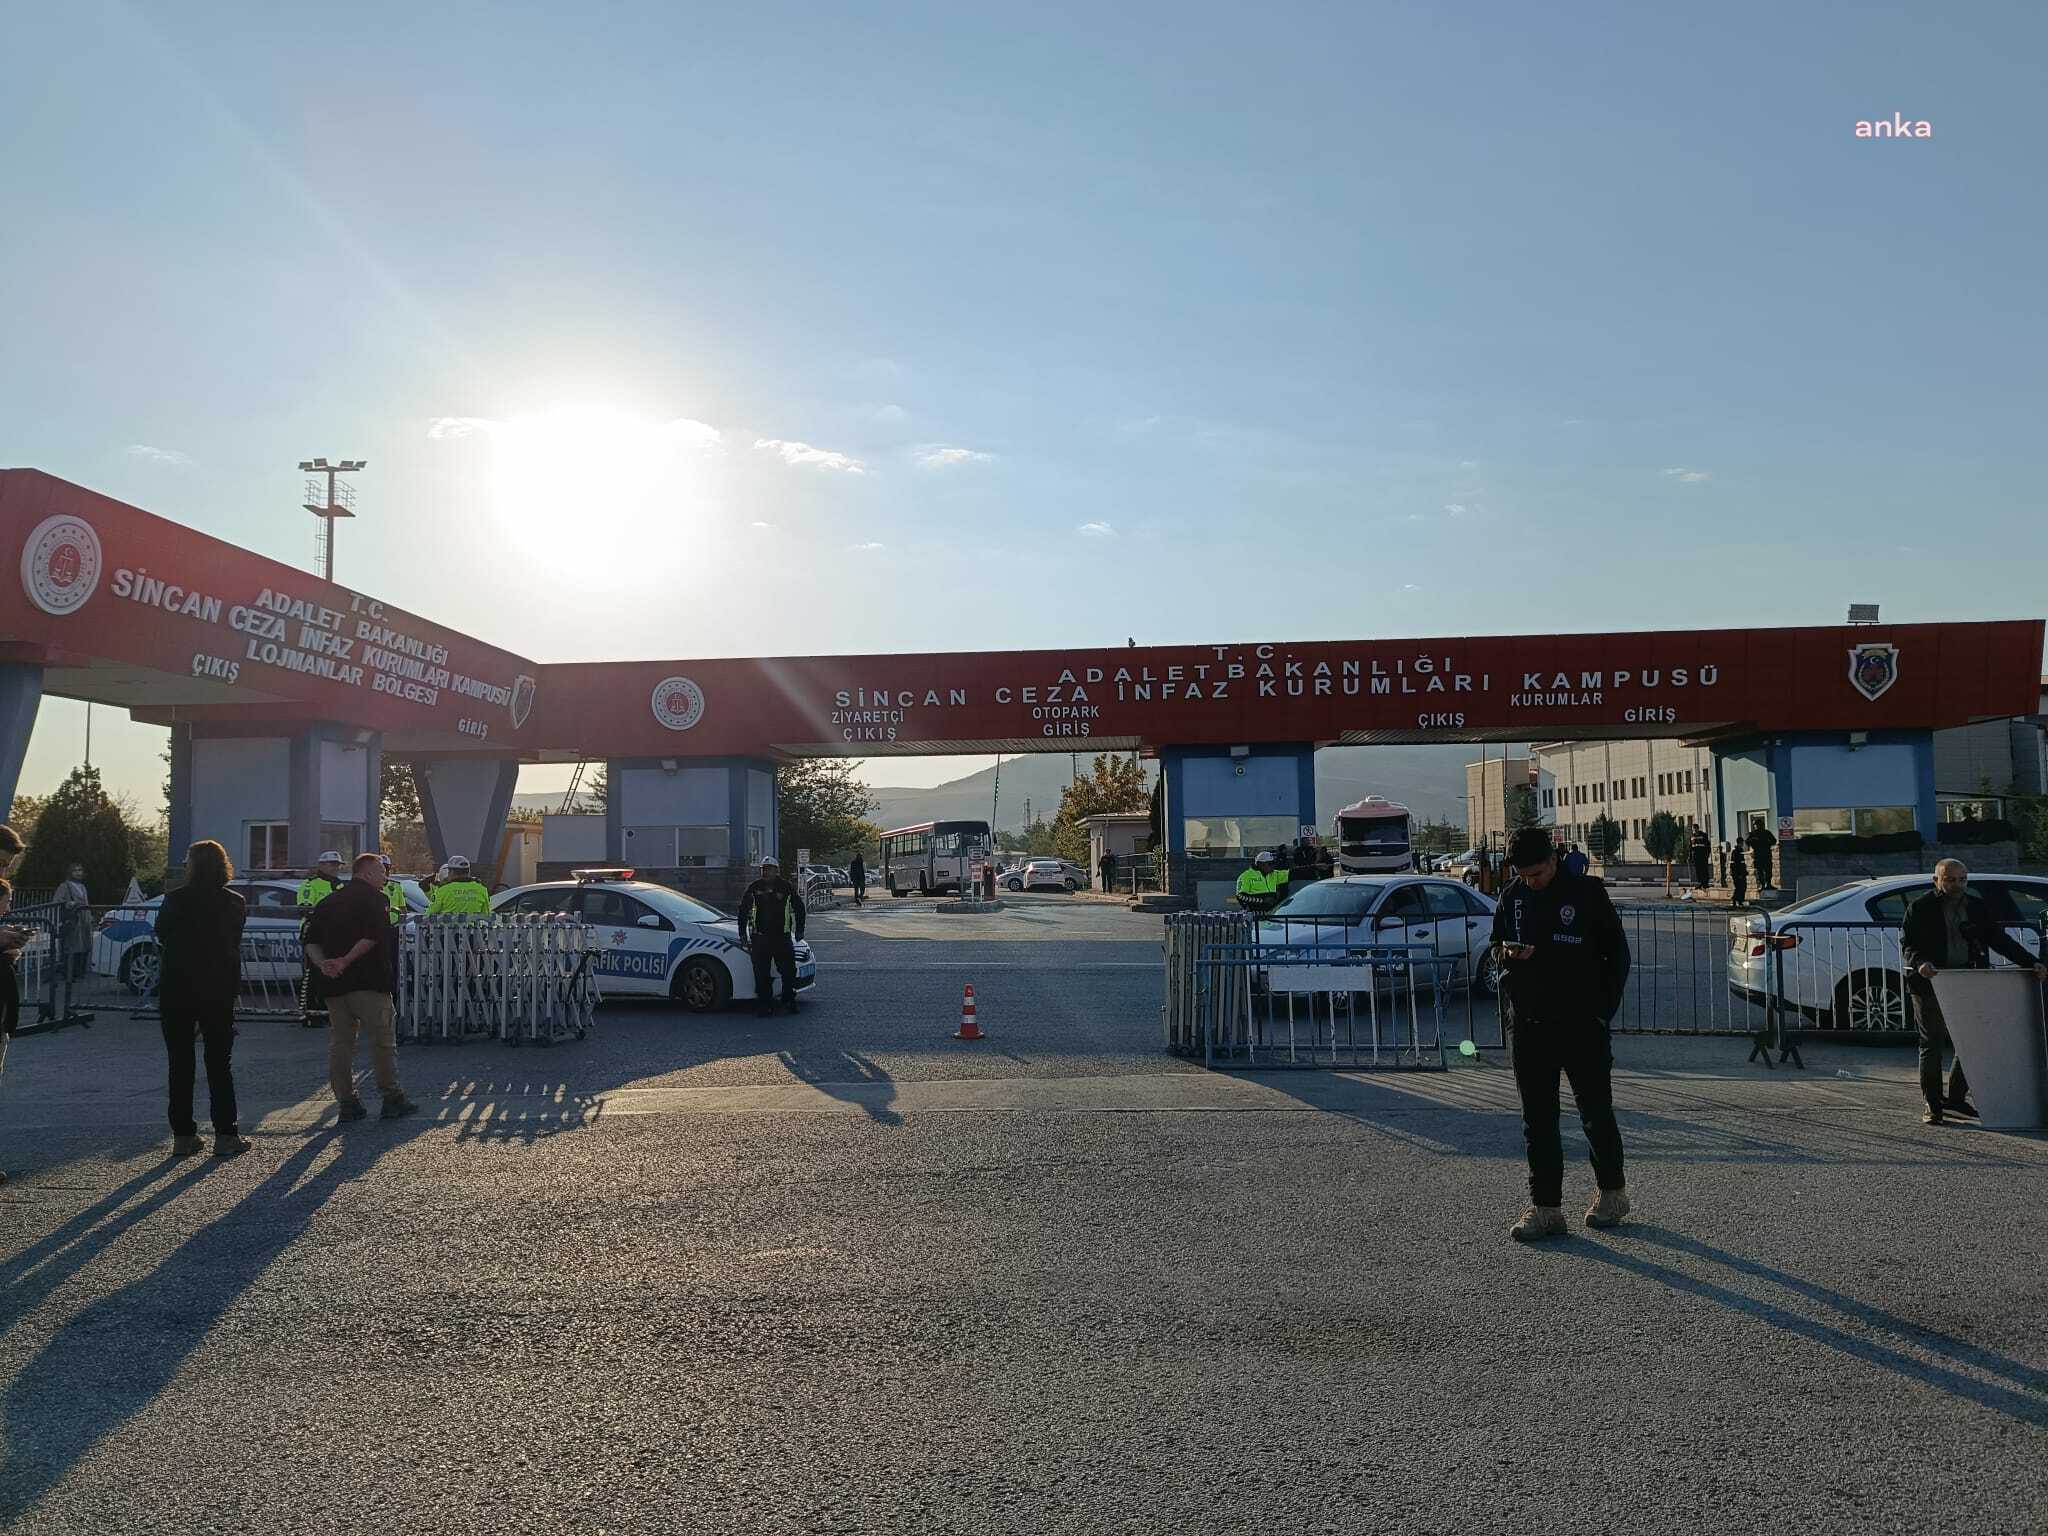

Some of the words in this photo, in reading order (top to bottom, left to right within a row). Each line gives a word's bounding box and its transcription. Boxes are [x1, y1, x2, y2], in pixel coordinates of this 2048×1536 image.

[110, 567, 222, 624] SİNCAN
[228, 605, 287, 642] CEZA
[298, 622, 354, 660] İNFAZ
[361, 645, 450, 689] KURUMLARI
[451, 673, 512, 706] KAMPUSÜ
[255, 588, 346, 631] ADALET
[355, 620, 449, 666] BAKANLIĞI
[191, 653, 241, 684] ÇIKIŞ
[245, 639, 364, 686] LOJMANLAR
[372, 670, 439, 706] BÖLGESİ
[1058, 664, 1211, 684] ADALET
[1227, 654, 1451, 679] BAKANLIĞI
[834, 687, 966, 708] SİNCAN
[995, 685, 1089, 704] CEZA
[1118, 681, 1229, 701] İNFAZ
[1259, 674, 1490, 697] KURUMLARI
[1523, 664, 1718, 690] KAMPUSÜ
[1510, 692, 1603, 707] KURUMLAR
[831, 707, 905, 724] ZİYARETÇİ
[1032, 705, 1101, 719] OTOPARK
[1418, 712, 1465, 729] ÇIKIŞ
[1624, 706, 1676, 724] GİRİŞ
[457, 718, 489, 741] GİRİŞ
[843, 726, 897, 743] ÇIKIŞ
[1043, 721, 1091, 738] GİRİŞ
[624, 953, 665, 976] POLİSİ
